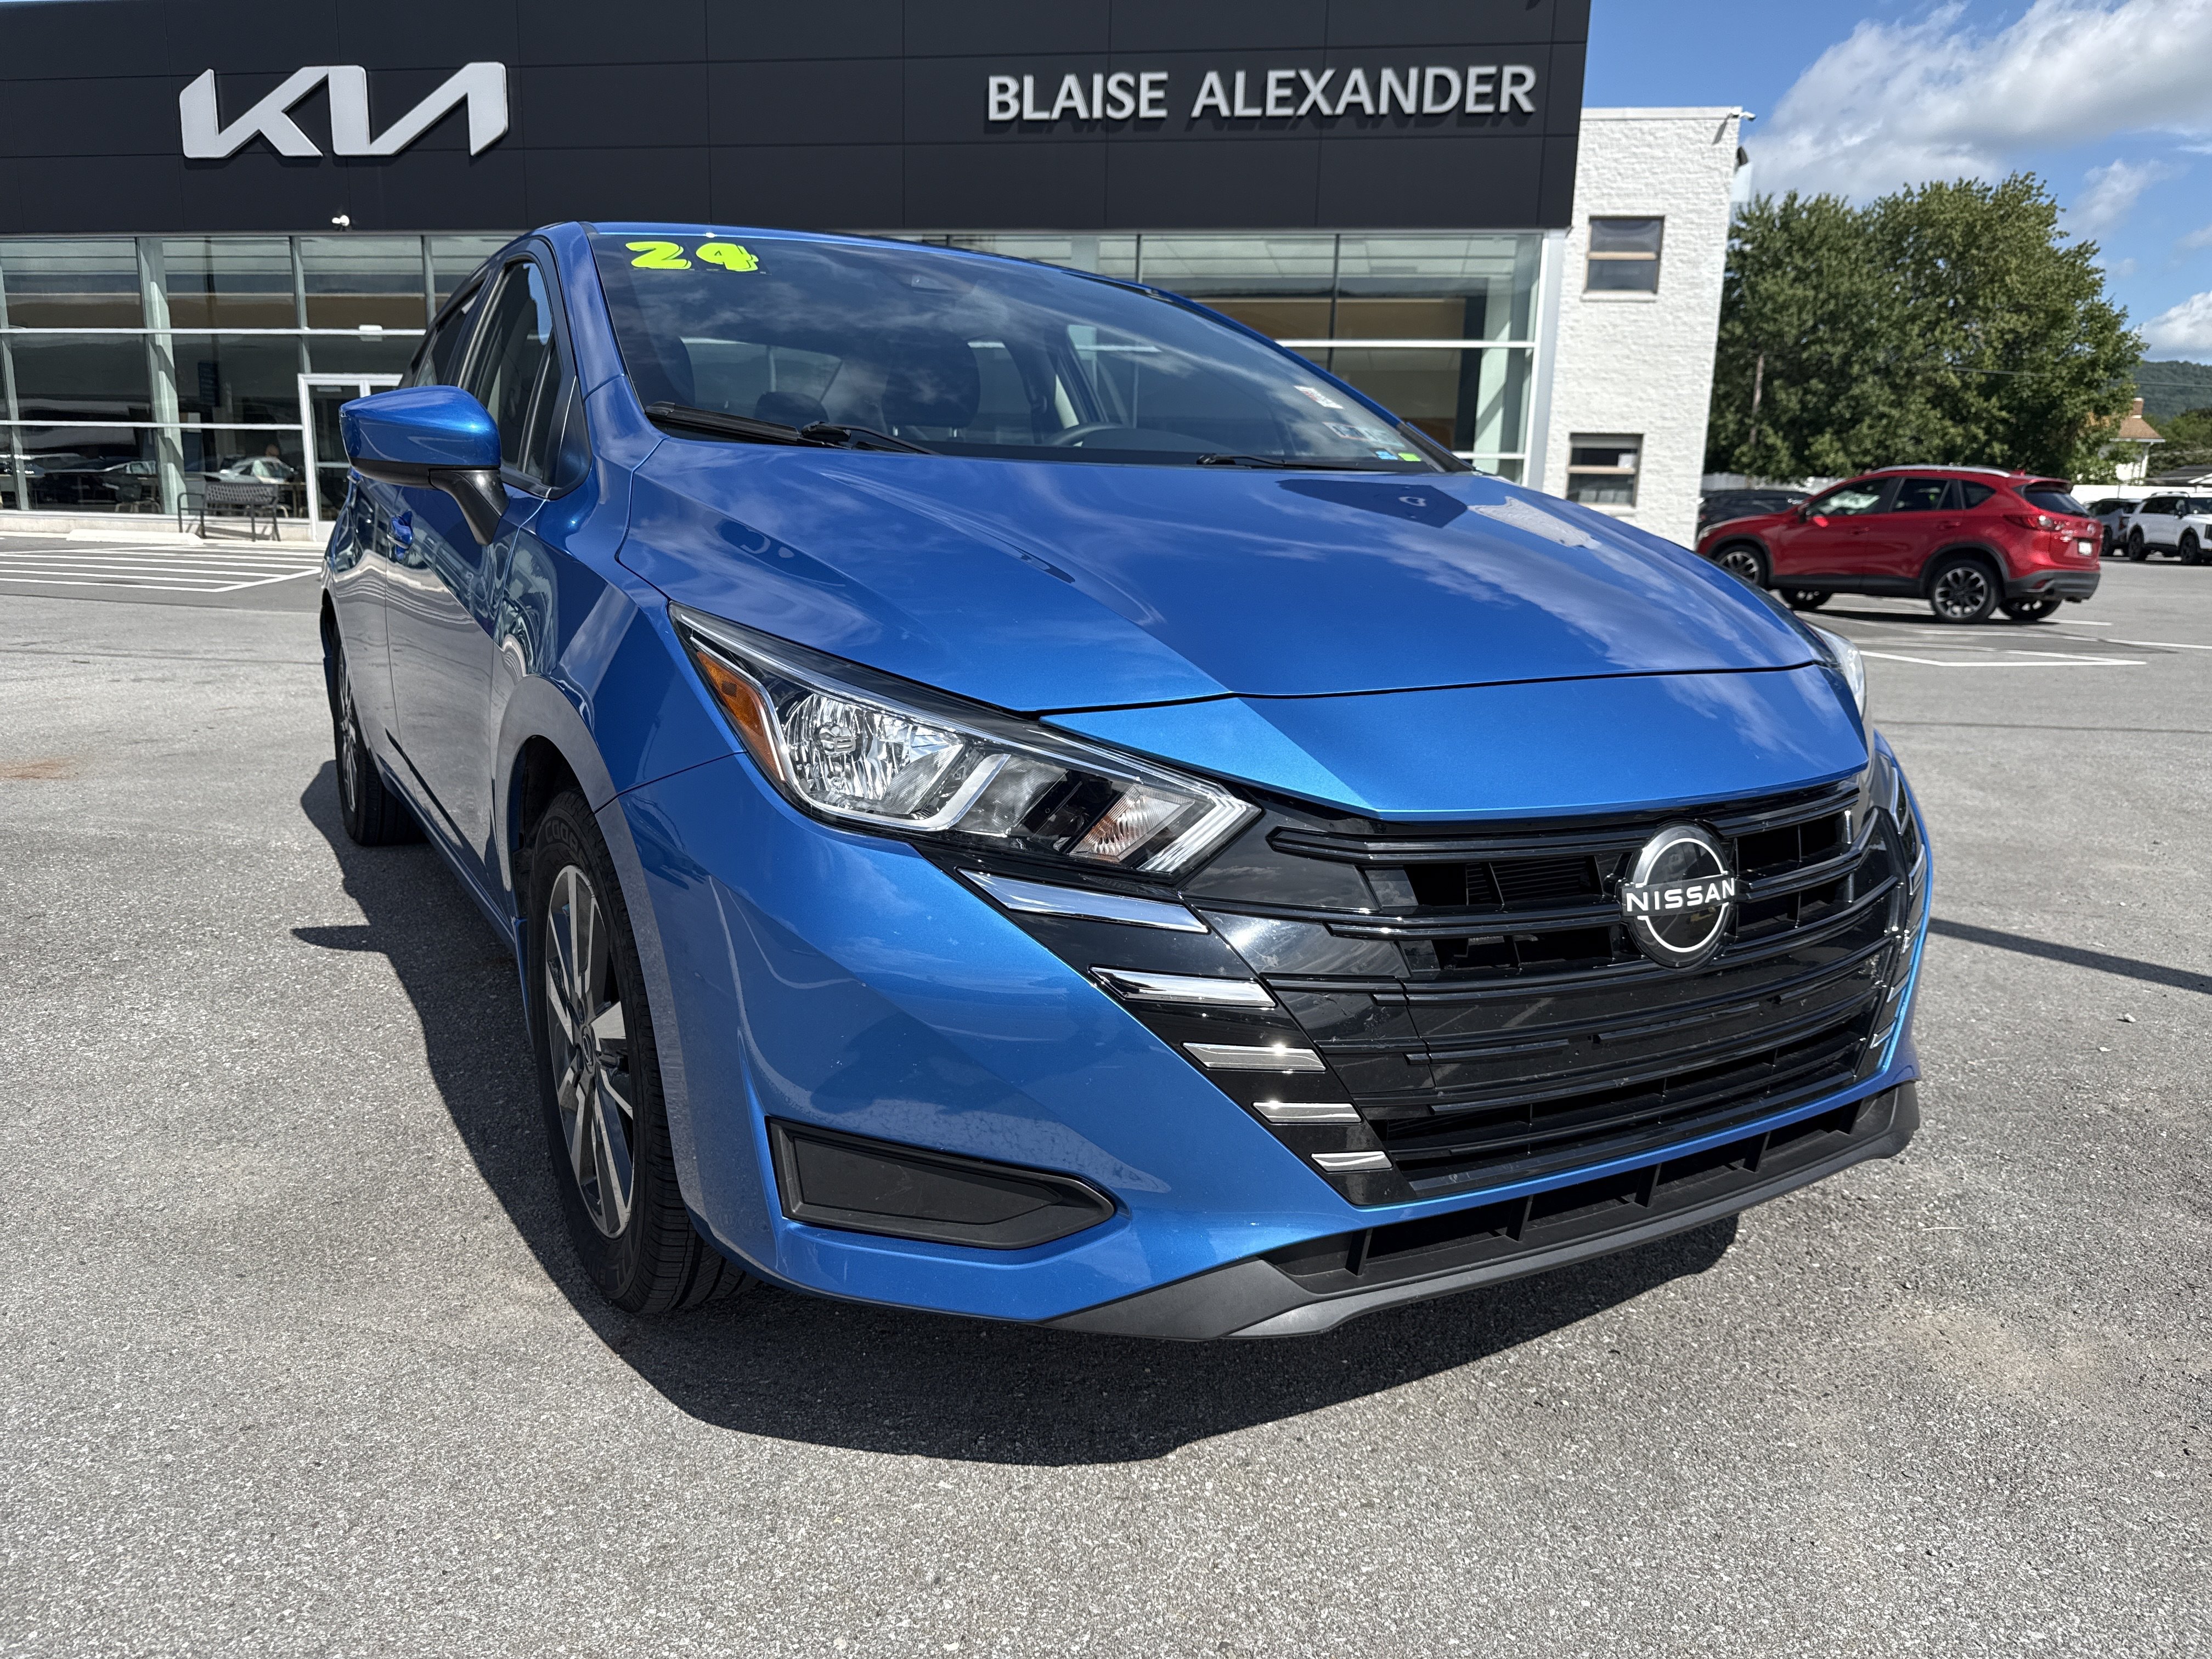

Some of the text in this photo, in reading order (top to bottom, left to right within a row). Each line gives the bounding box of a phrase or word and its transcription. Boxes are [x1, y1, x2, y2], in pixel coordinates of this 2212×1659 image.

[179, 61, 509, 159] KIA
[988, 64, 1537, 121] BLAISE ALEXANDER
[625, 241, 760, 272] 24
[1626, 878, 1735, 912] NISSAN
